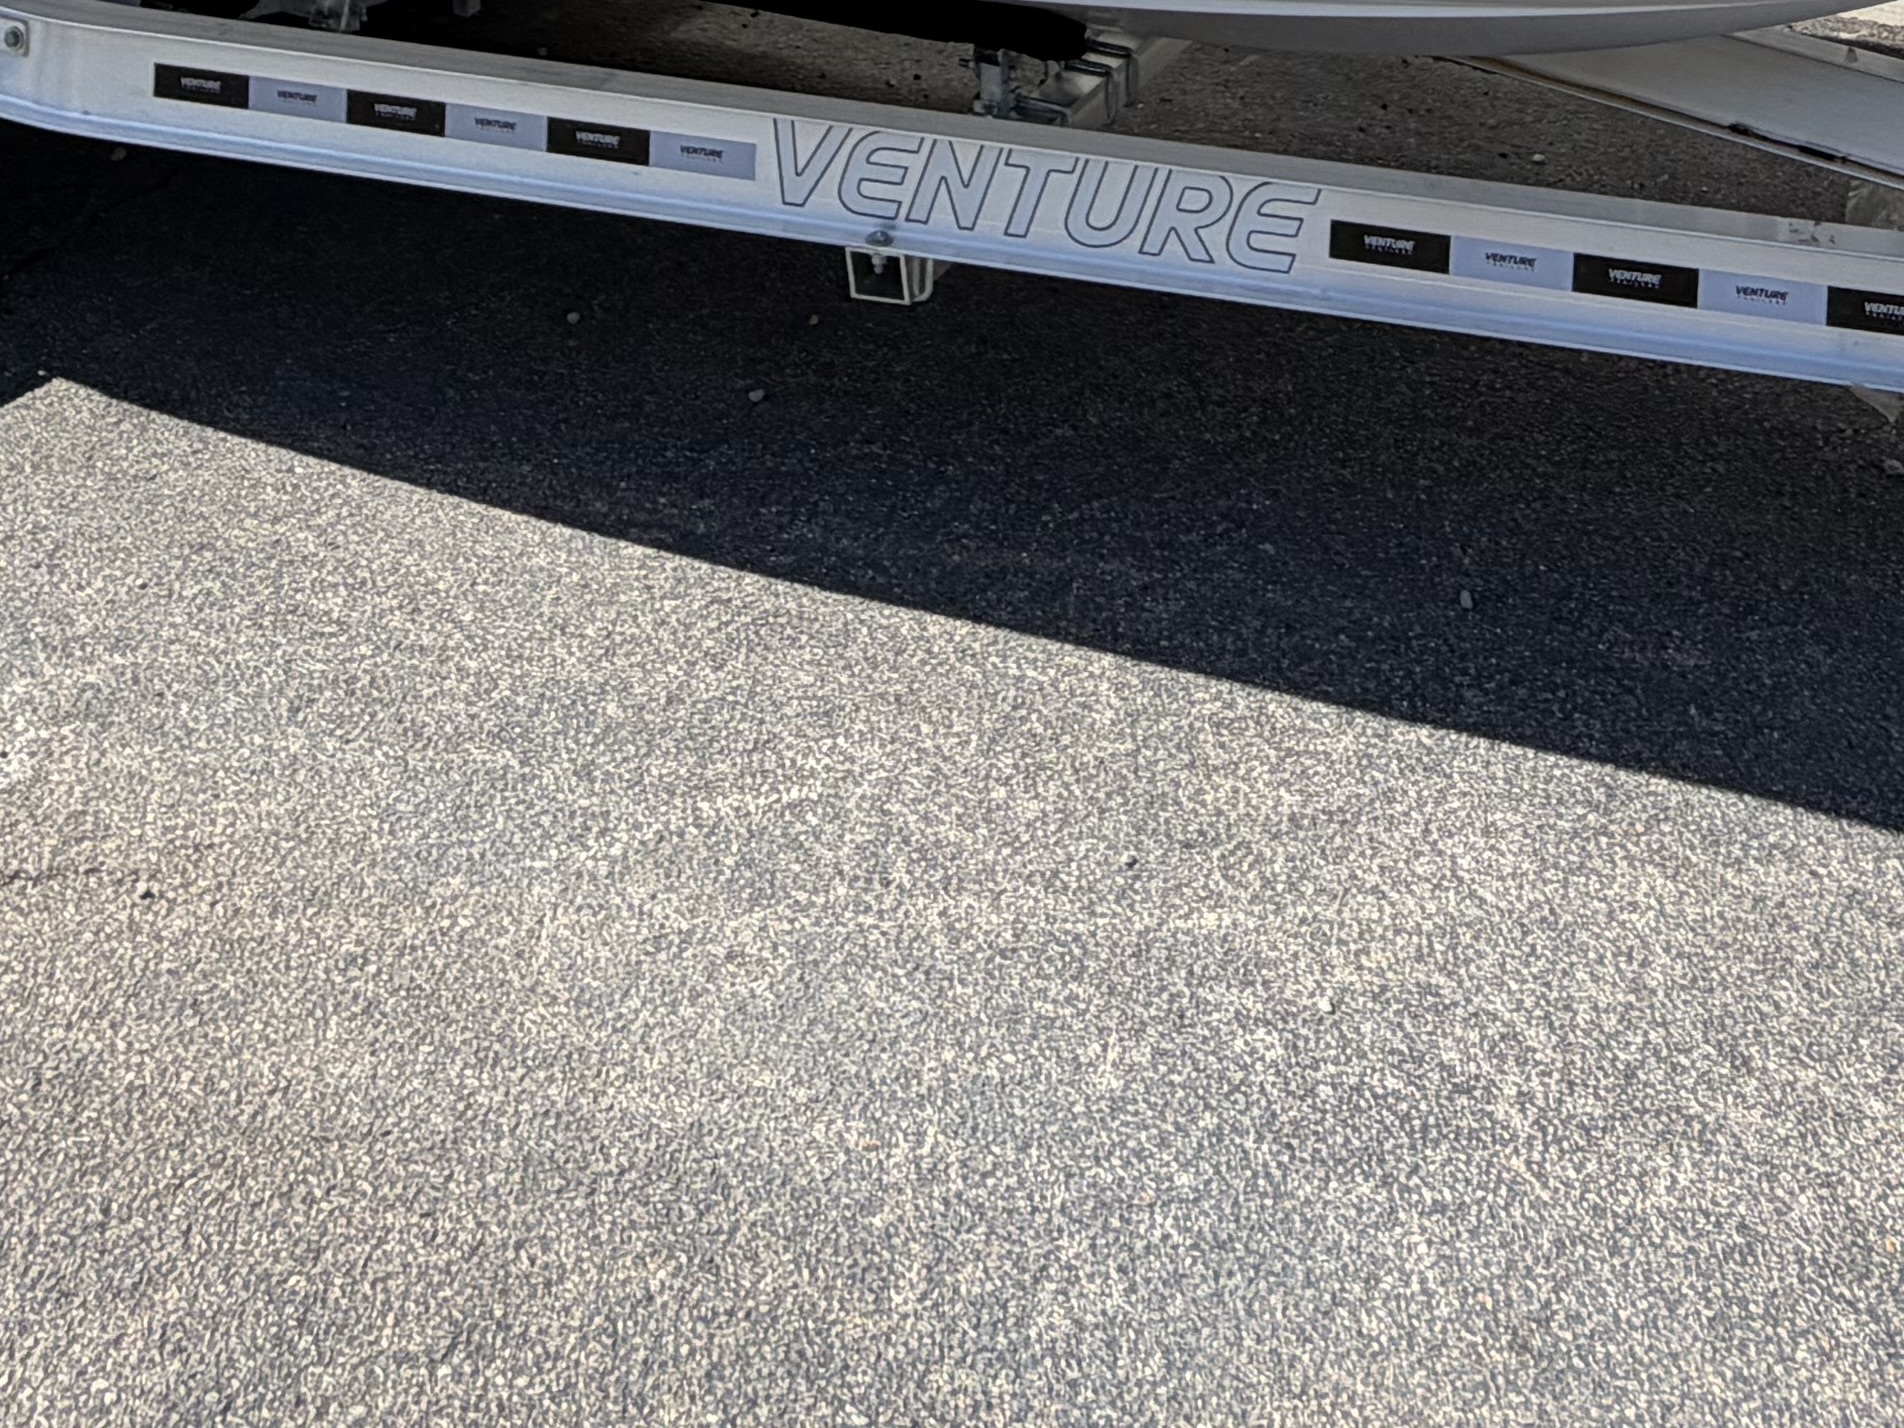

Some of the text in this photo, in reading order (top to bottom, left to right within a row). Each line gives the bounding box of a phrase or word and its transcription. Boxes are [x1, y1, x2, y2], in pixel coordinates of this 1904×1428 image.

[773, 117, 1322, 274] VENTURE
[1363, 235, 1415, 251] VENTURE
[1485, 252, 1537, 267] VENTURE
[1609, 268, 1662, 284] VENTURE
[1736, 285, 1789, 301] VENTURE
